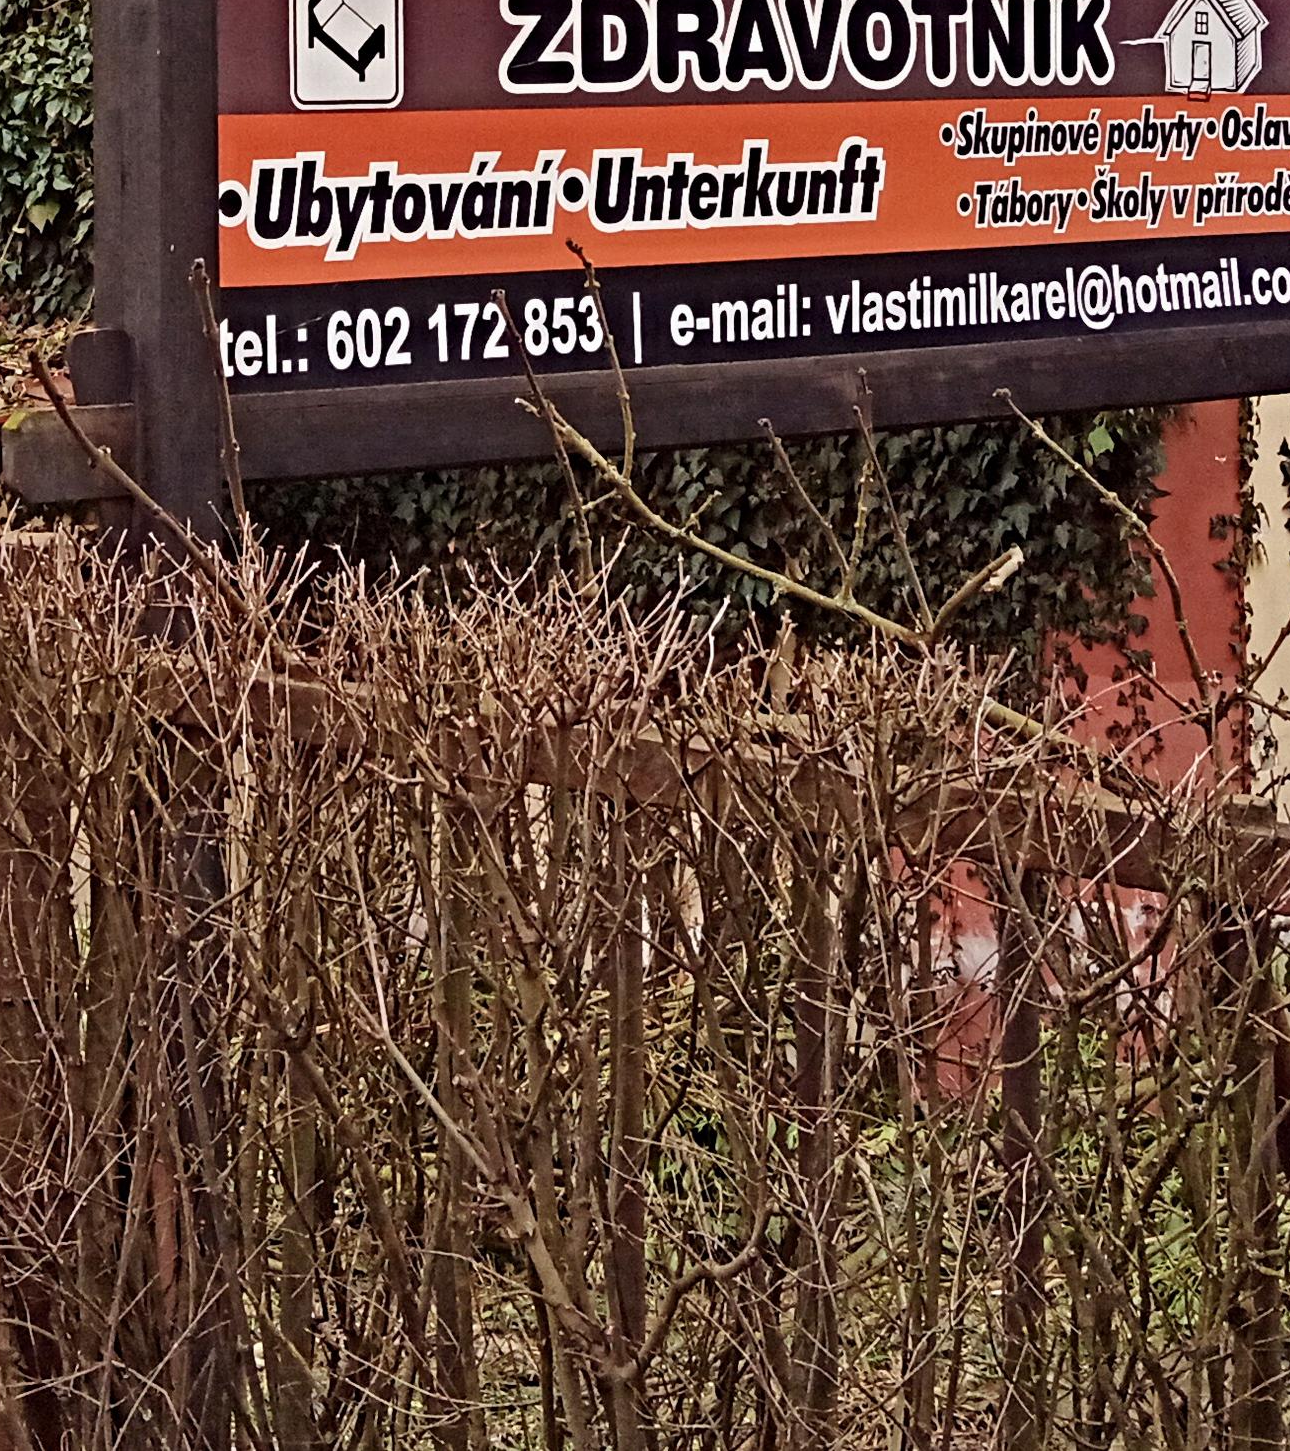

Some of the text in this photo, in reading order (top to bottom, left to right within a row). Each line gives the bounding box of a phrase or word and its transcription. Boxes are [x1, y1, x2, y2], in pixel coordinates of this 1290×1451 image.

[954, 107, 1101, 165] Skupinové
[1106, 105, 1205, 163] pobyty
[248, 137, 885, 261] Ubytování Unterkunft
[974, 179, 1073, 232] Tábory
[1090, 166, 1167, 228] Školy
[1171, 185, 1191, 219] v
[221, 315, 308, 377] tel.:
[327, 307, 411, 370] 602
[429, 302, 509, 362] 172
[525, 296, 604, 355] 853
[670, 284, 811, 347] e-mail:
